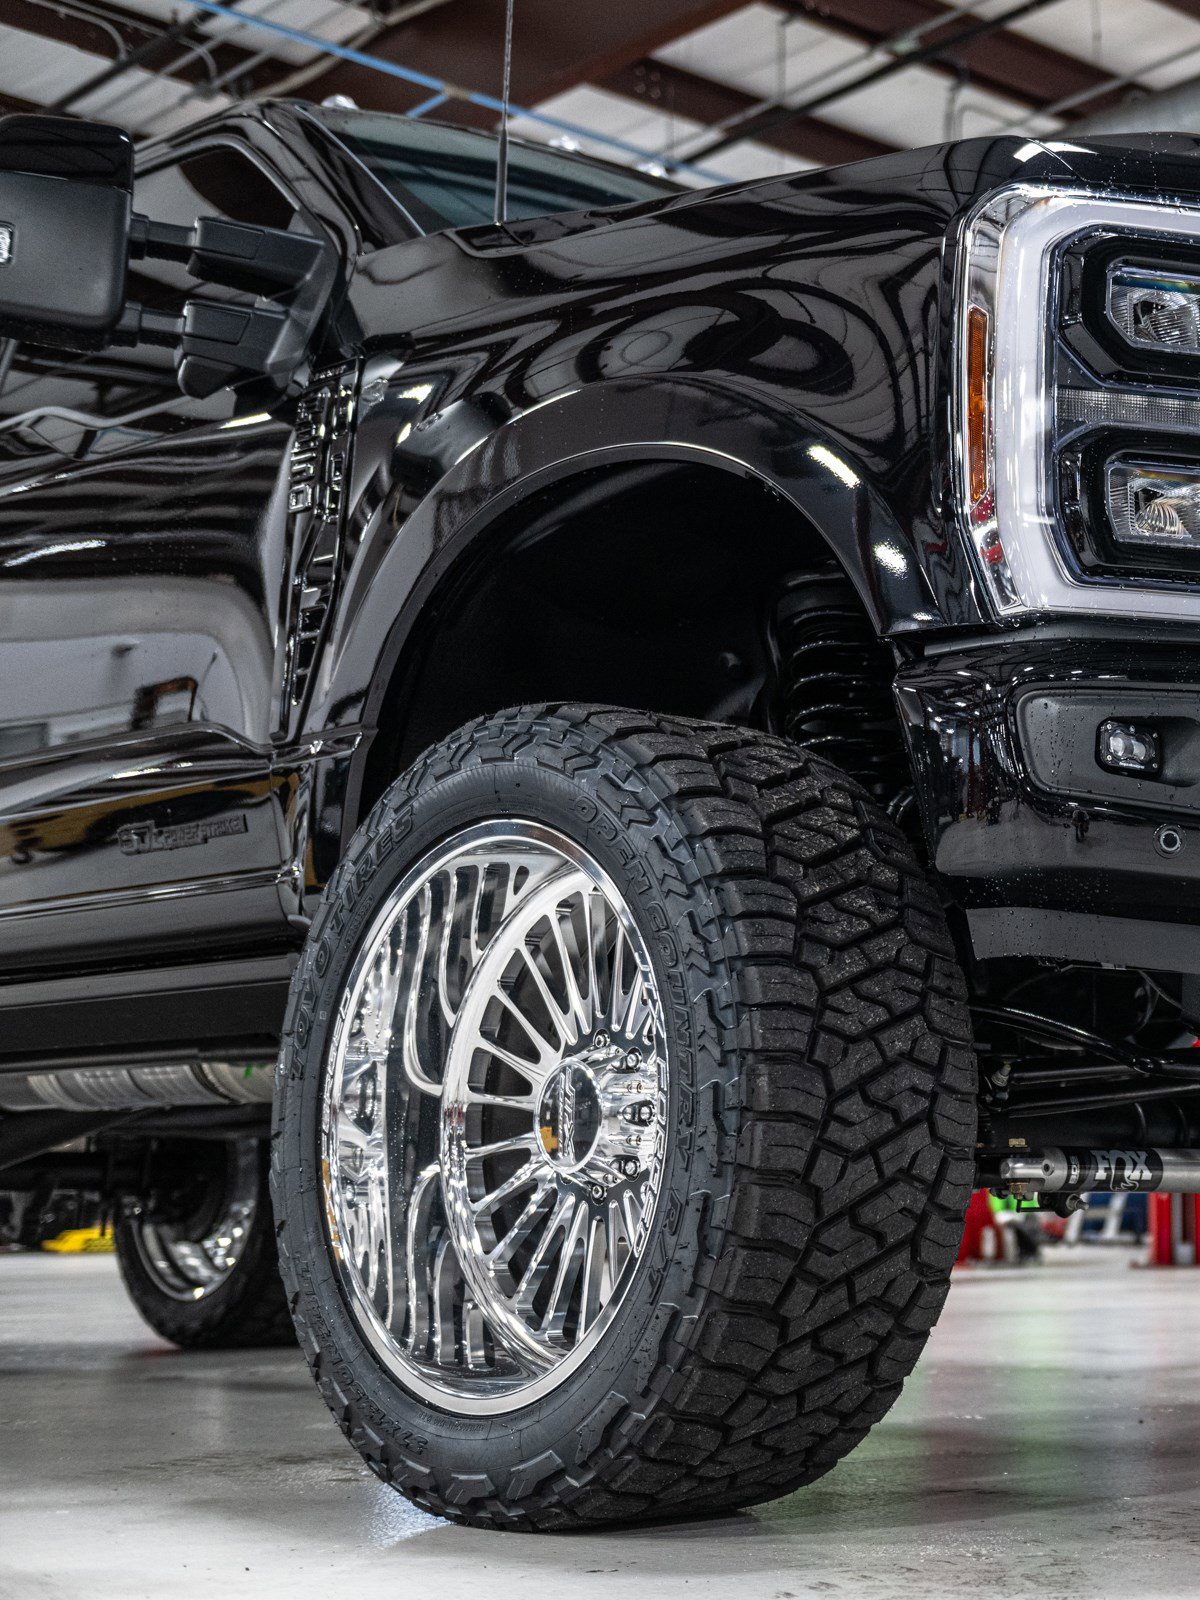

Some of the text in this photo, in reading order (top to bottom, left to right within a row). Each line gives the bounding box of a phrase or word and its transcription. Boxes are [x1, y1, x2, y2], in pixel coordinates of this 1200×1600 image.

[289, 936, 331, 1081] TOYO
[328, 810, 414, 938] TIRES
[573, 795, 652, 896] OPEN
[646, 901, 696, 1173] COUNTRY
[634, 1056, 669, 1259] FORGED
[1090, 1150, 1153, 1191] FOX
